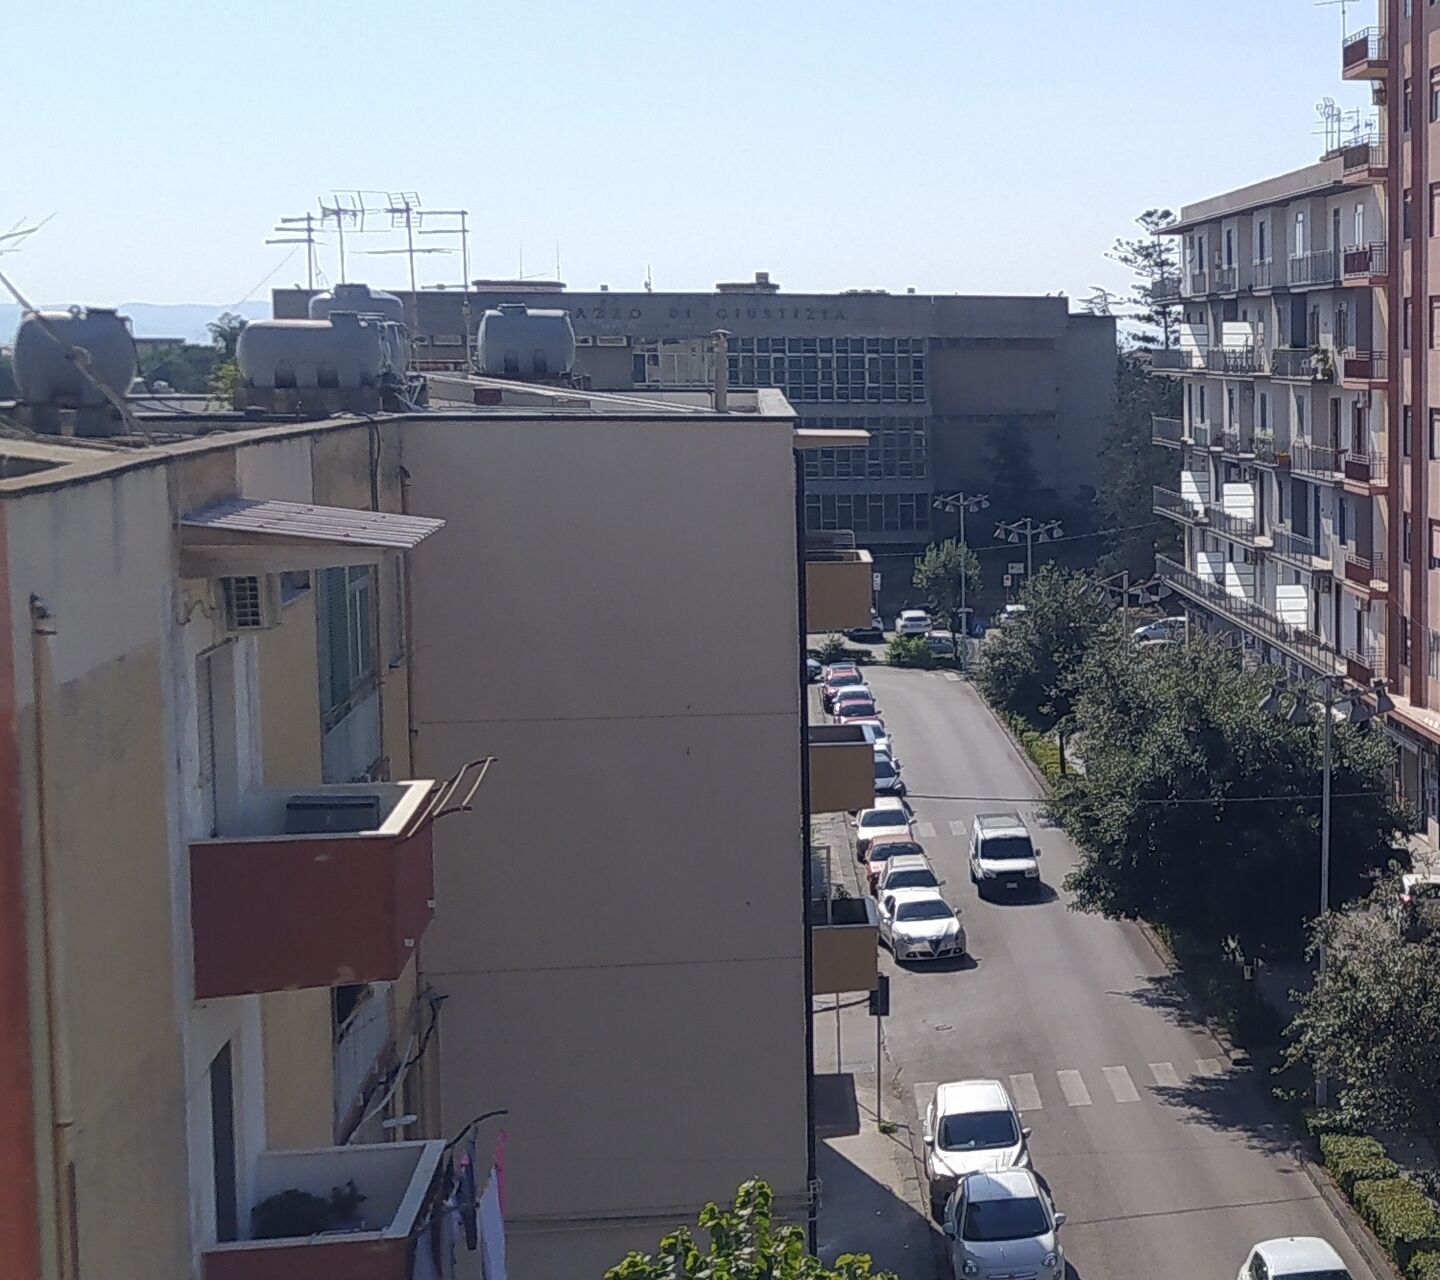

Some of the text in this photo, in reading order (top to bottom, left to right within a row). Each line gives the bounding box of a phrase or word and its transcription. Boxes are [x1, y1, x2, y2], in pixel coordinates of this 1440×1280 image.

[575, 307, 846, 320] AZZO DI GIUSTIZIA
